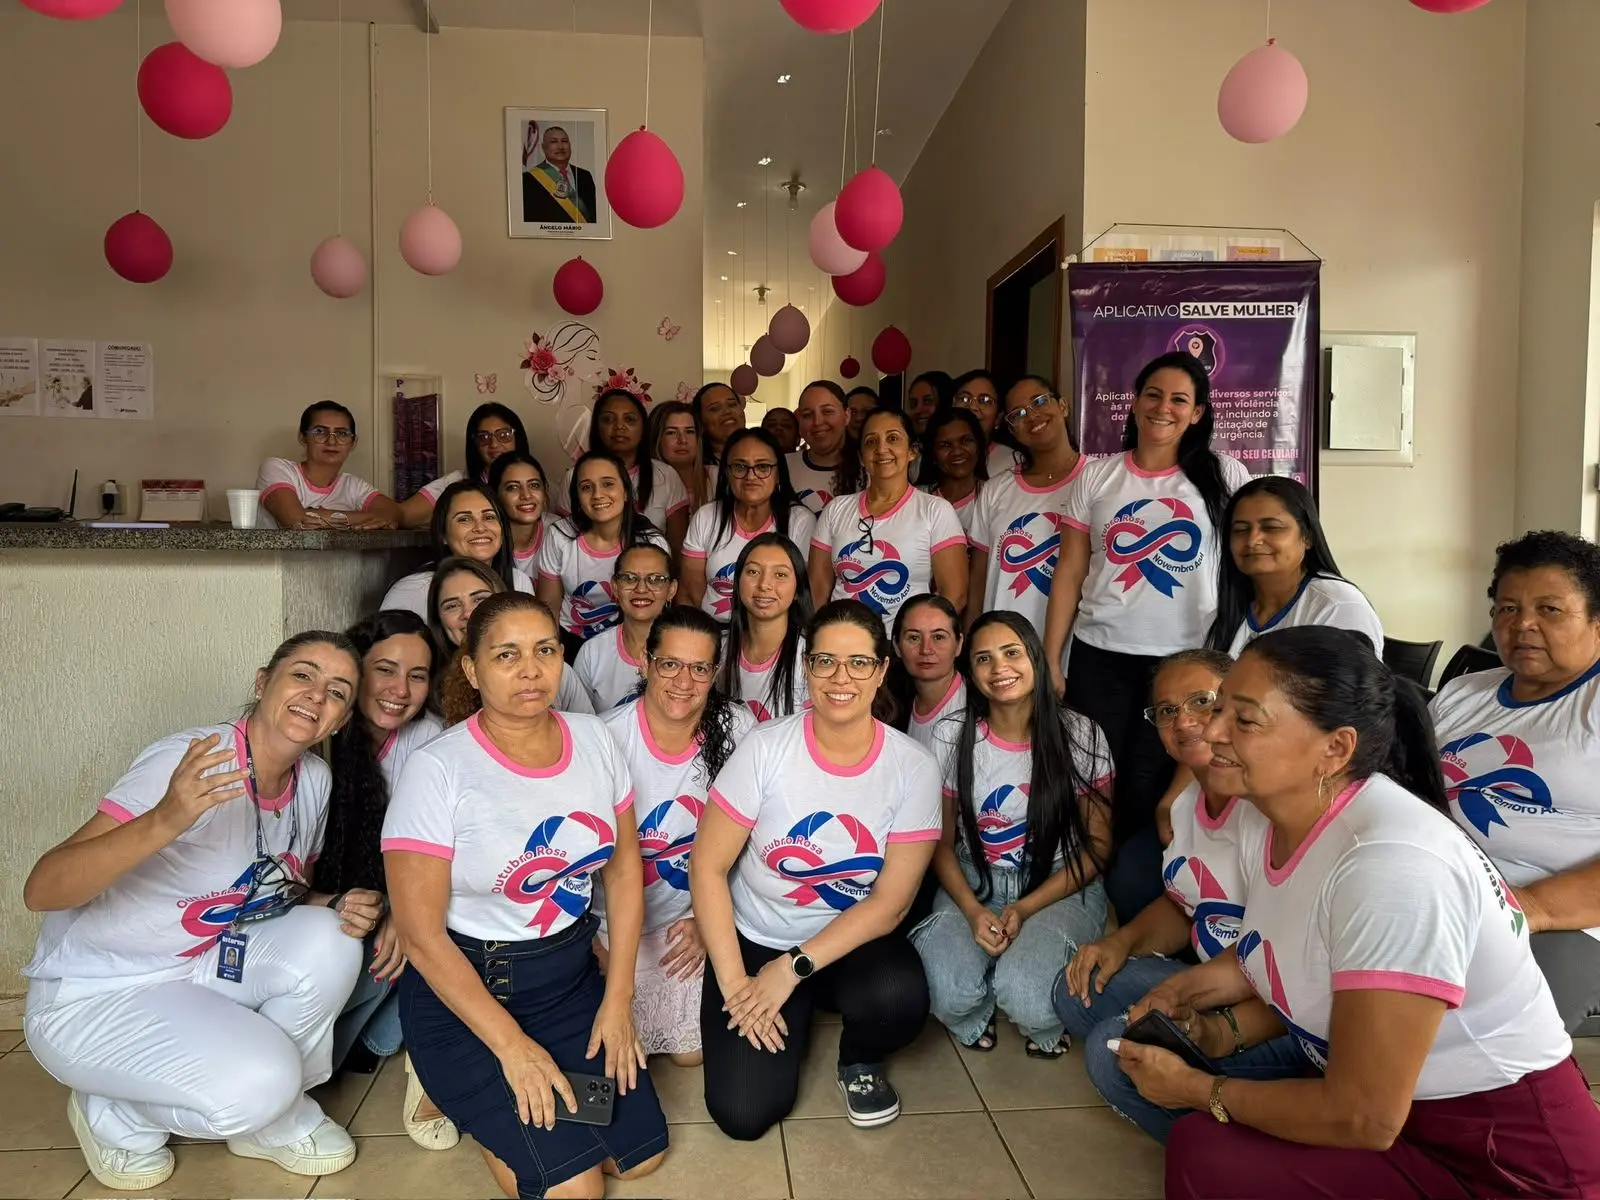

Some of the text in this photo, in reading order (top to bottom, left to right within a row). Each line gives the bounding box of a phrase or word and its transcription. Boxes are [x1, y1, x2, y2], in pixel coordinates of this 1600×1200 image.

[1093, 304, 1295, 318] APLICATIVO SALVE MULHER
[1209, 389, 1251, 399] diversos
[1110, 401, 1122, 411] às
[1235, 399, 1279, 409] violência
[1226, 410, 1270, 419] incluindo
[1213, 420, 1268, 431] licitação de
[1220, 430, 1265, 441] urgência.
[1243, 450, 1260, 459] SEU
[1122, 514, 1146, 526] Rosa
[1152, 553, 1194, 573] Novembro
[869, 585, 901, 605] Novembro
[1443, 752, 1468, 769] Rosa
[646, 829, 669, 840] Rosa
[796, 835, 823, 855] Rosa
[492, 846, 568, 894] Outubro Rosa
[831, 880, 871, 896] Novemb
[176, 884, 251, 909] Outubro Ro
[1207, 919, 1239, 939] ovemb
